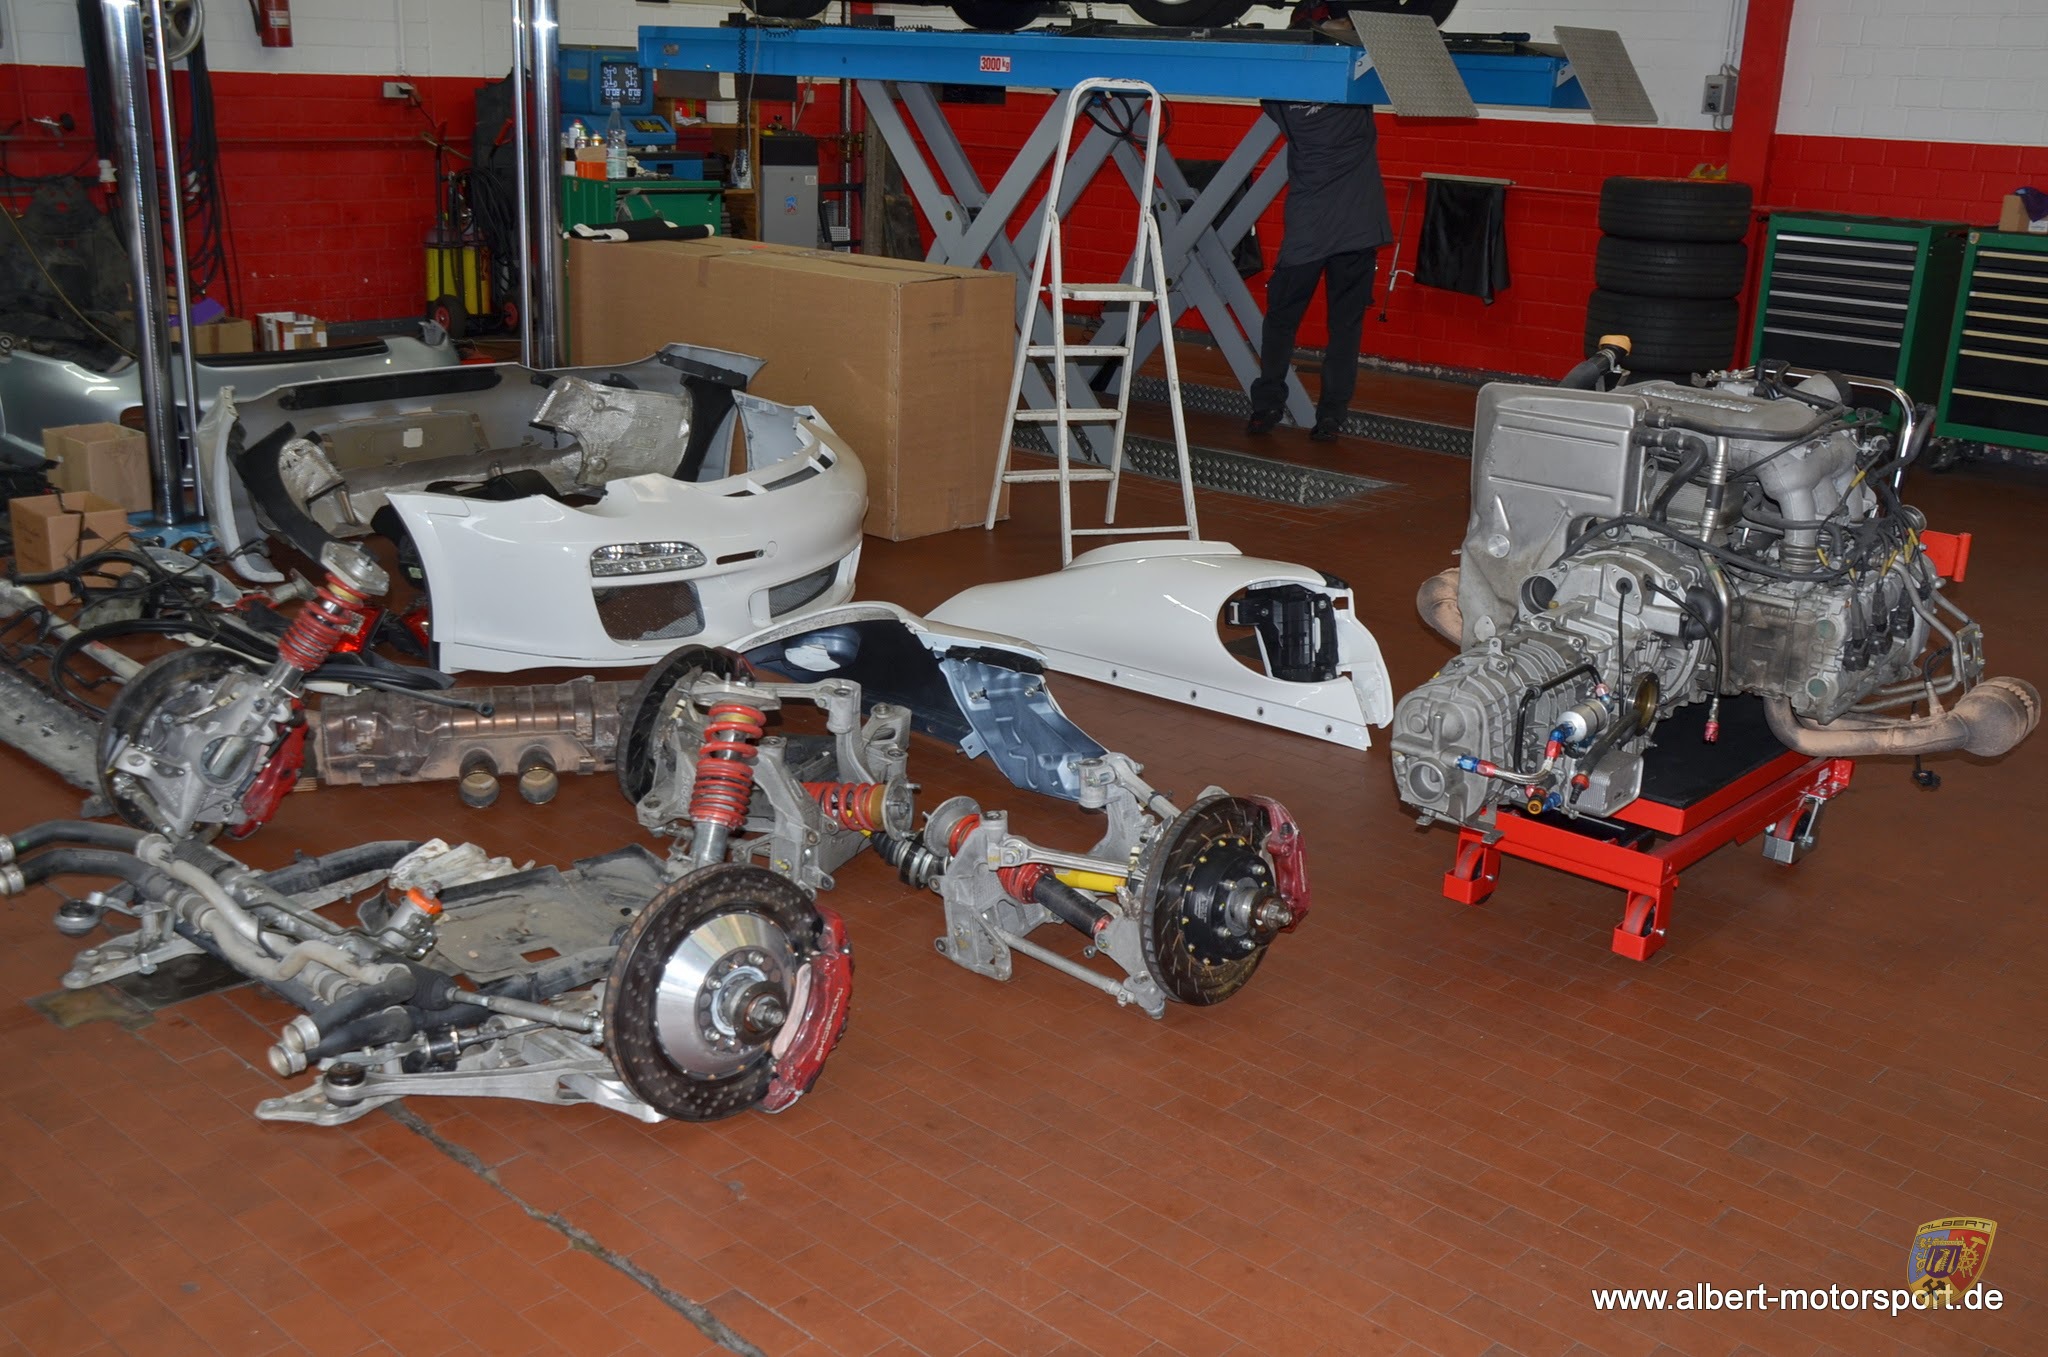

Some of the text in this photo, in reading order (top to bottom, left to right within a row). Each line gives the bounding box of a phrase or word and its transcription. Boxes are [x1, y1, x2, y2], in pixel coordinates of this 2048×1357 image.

[981, 57, 1010, 71] 3000 kg
[815, 987, 844, 1061] PORSCHE
